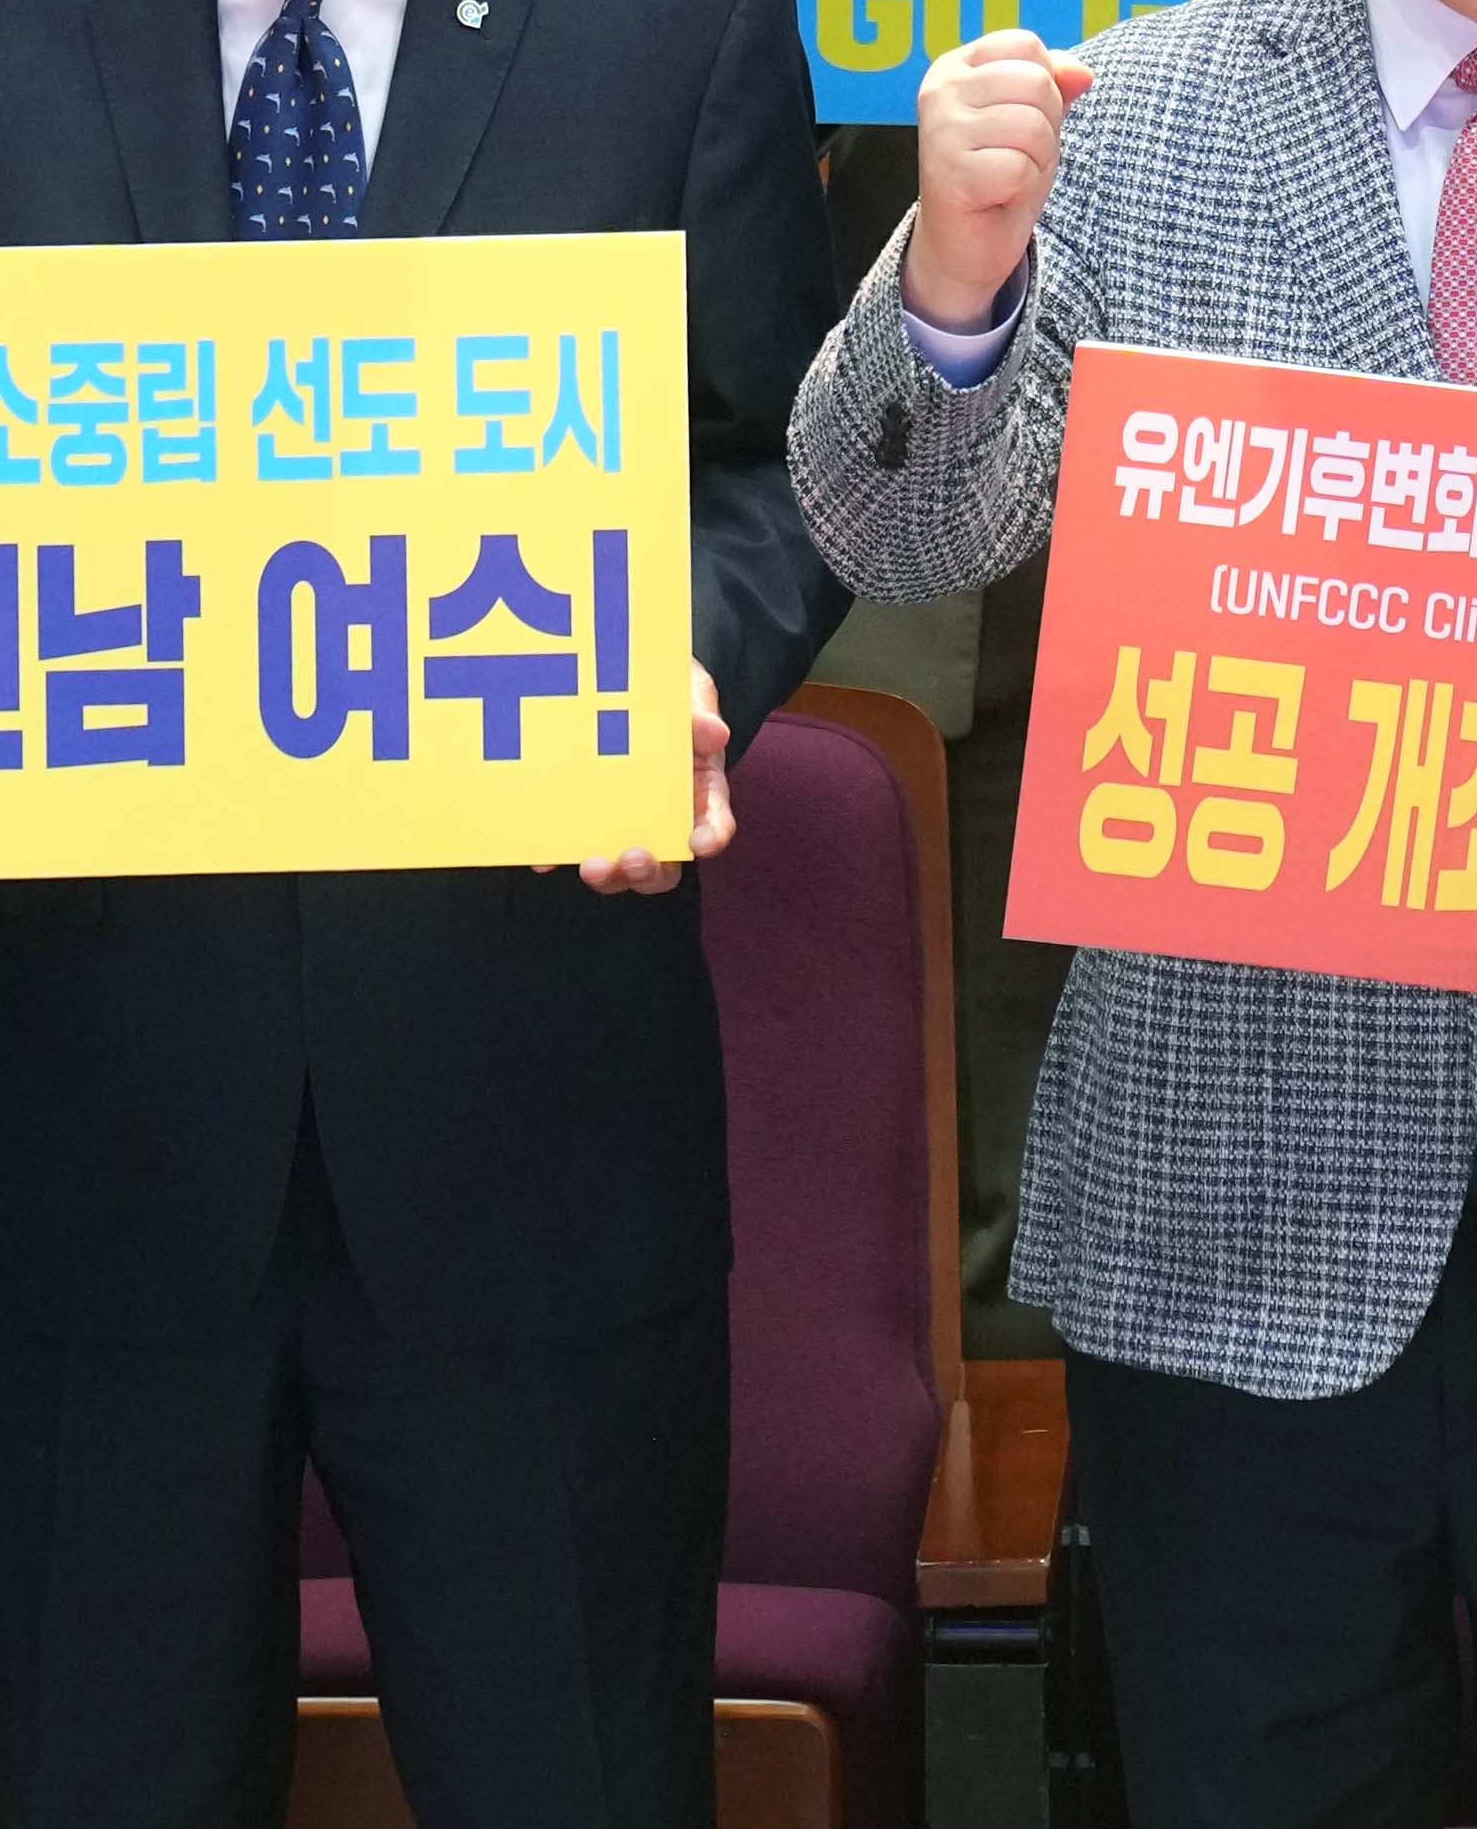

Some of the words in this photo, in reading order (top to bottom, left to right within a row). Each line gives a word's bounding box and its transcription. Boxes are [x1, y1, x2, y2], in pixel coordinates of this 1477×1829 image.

[251, 336, 422, 482] 선도
[452, 329, 622, 476] 도시
[256, 528, 631, 764] 여수!
[1209, 562, 1409, 636] (UNFCCC
[1077, 643, 1307, 893] 성공
